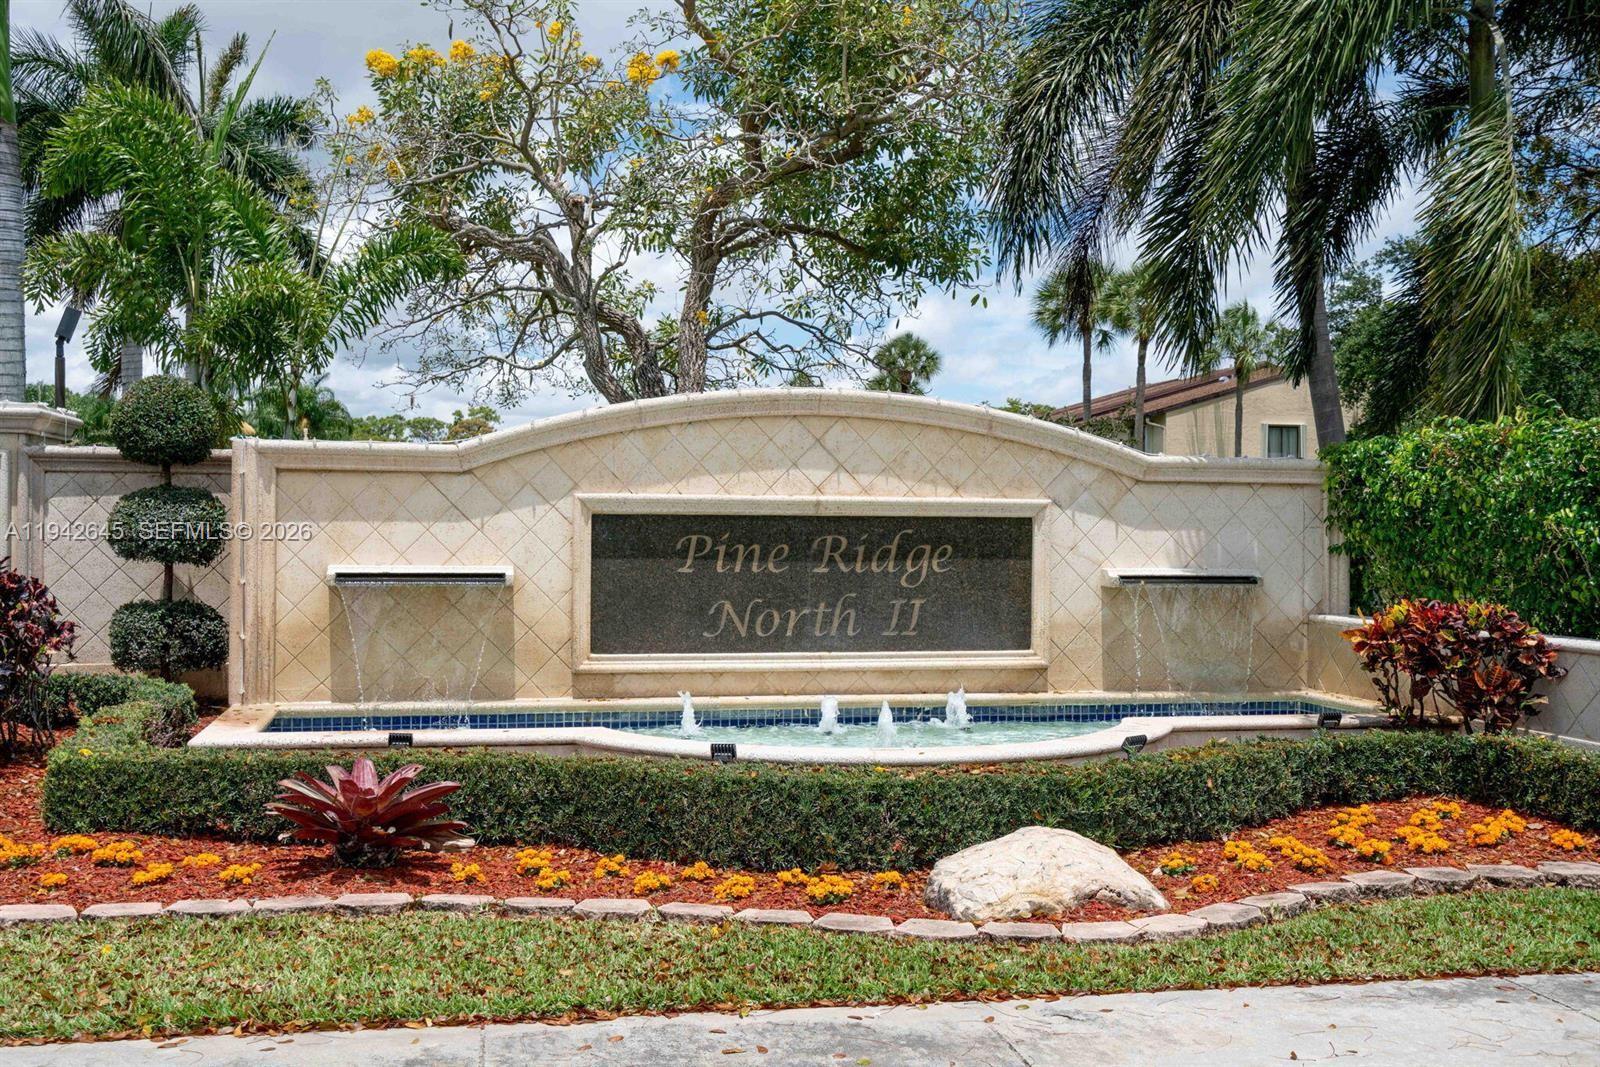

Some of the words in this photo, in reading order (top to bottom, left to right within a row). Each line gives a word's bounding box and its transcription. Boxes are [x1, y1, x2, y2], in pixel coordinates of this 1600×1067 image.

[675, 533, 790, 574] Pine
[811, 529, 953, 588] Ridge
[703, 593, 862, 638] North
[881, 598, 926, 637] II
